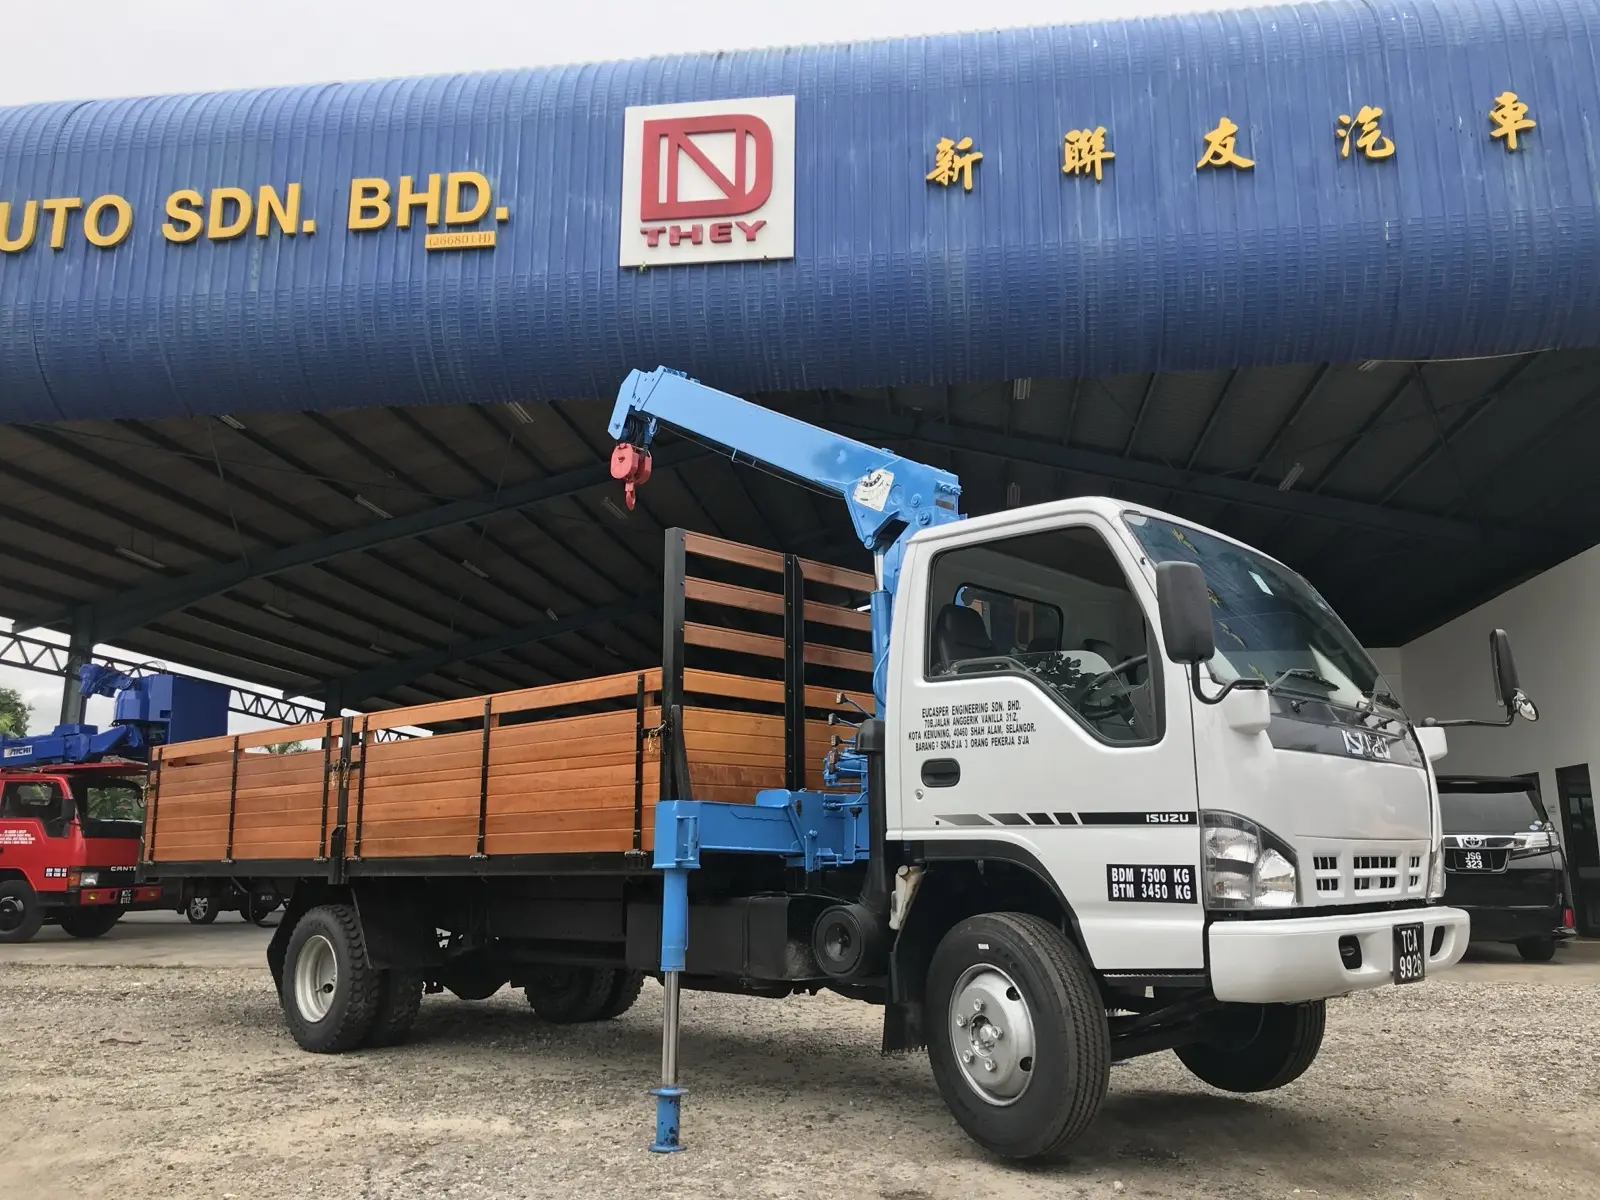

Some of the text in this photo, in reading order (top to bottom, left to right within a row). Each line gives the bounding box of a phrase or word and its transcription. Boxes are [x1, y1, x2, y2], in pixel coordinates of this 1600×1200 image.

[162, 182, 317, 243] SDN.
[348, 171, 509, 232] BHD.
[640, 220, 768, 247] THEY
[922, 700, 1021, 718] EUCASPER ENGINEERING SDN. BHD.
[953, 715, 979, 726] ANGGERIK
[981, 713, 1003, 723] VANILLA
[908, 731, 921, 740] KOTA
[924, 729, 951, 740] KEMUNING,
[971, 726, 985, 736] SHAH
[988, 725, 1003, 736] ALAM,
[1006, 722, 1036, 733] SELANGOR.
[971, 737, 988, 748] ORANG
[991, 735, 1015, 746] PEKERJA
[1145, 813, 1189, 823] ISUZU
[1465, 851, 1482, 860] JSG
[1465, 860, 1483, 869] 323
[1111, 867, 1190, 883] BDM 7500 KG
[1112, 883, 1191, 900] BTM 3450 KG
[1401, 929, 1418, 954] TCA
[1399, 952, 1422, 979] 9926
